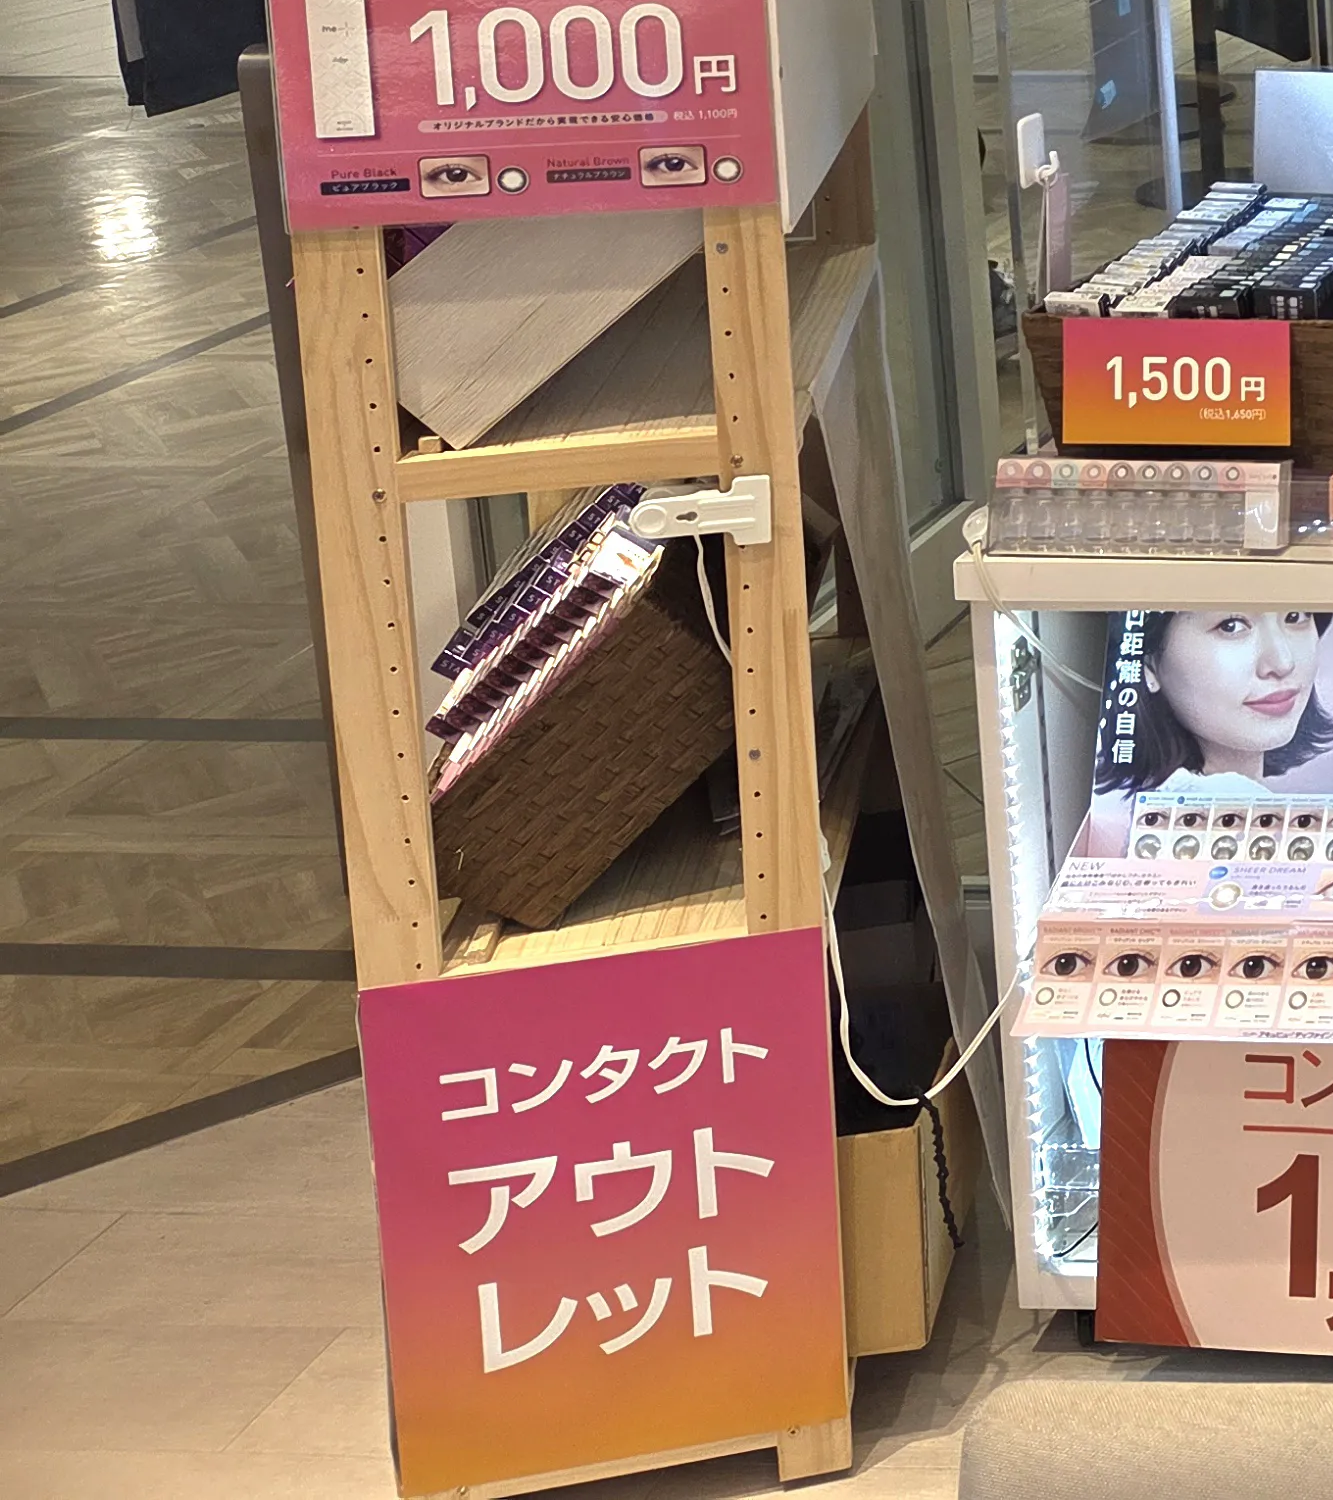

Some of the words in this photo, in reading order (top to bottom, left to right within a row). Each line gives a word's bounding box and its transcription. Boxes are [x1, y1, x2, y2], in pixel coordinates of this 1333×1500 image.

[408, 3, 737, 111] 1,000円
[699, 109, 737, 119] 1,100円
[331, 169, 359, 180] Pure
[363, 167, 397, 178] Black
[1105, 356, 1266, 408] 1,500円
[1198, 408, 1267, 420] (税込1,650円)
[1069, 862, 1105, 871] NEW
[439, 1027, 769, 1121] コンタクト
[448, 1127, 775, 1255] アウト
[477, 1245, 769, 1373] レット
